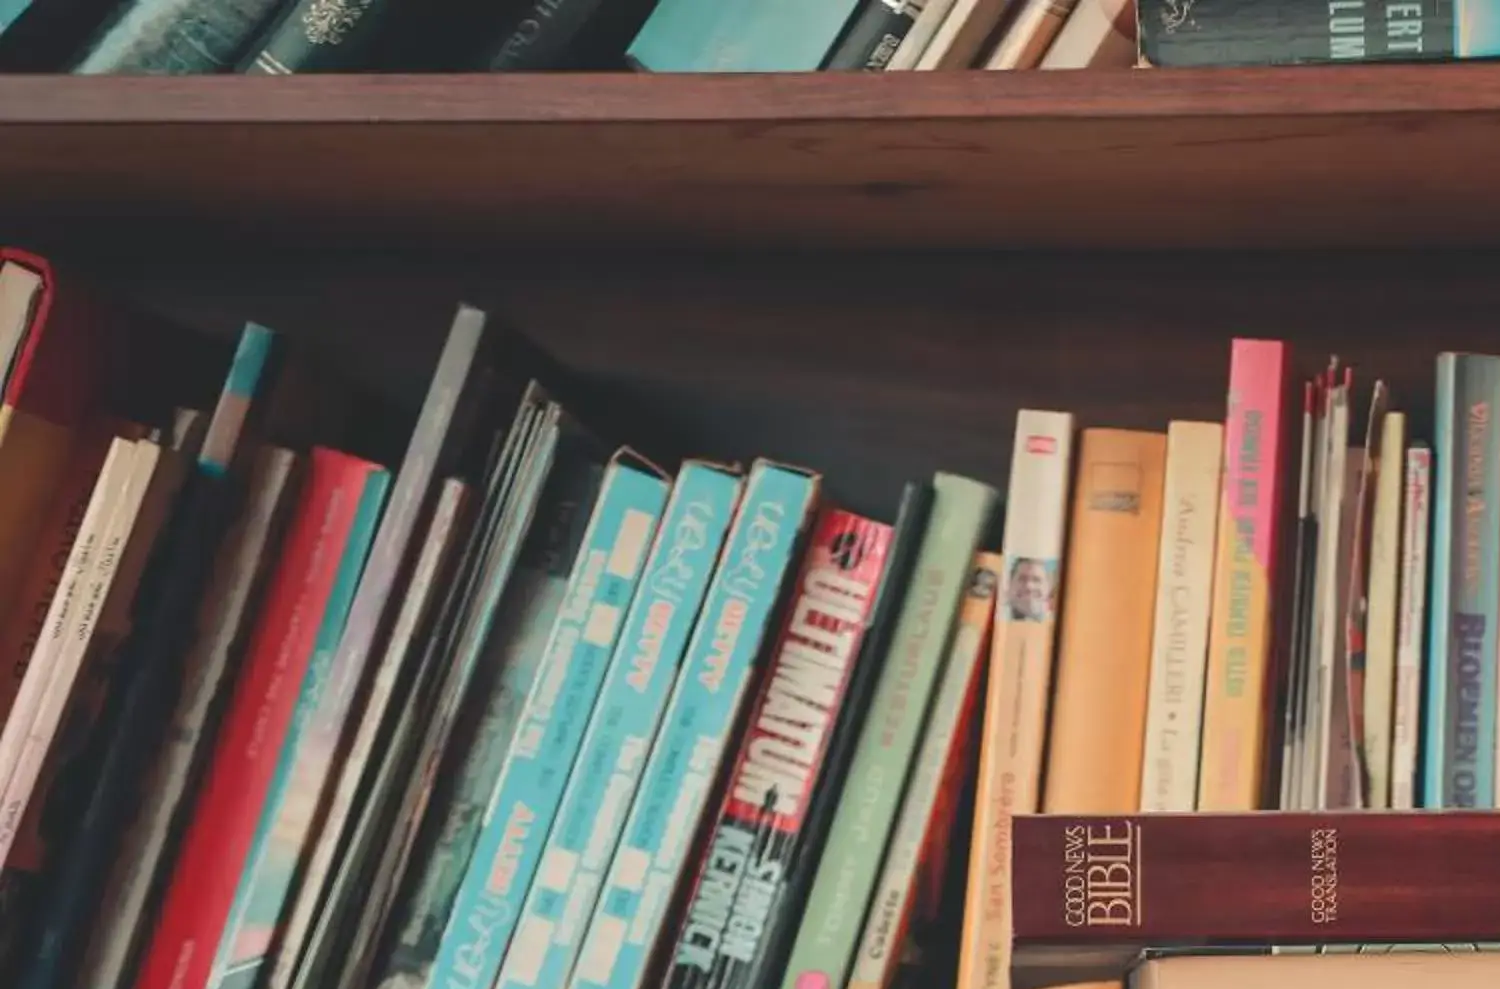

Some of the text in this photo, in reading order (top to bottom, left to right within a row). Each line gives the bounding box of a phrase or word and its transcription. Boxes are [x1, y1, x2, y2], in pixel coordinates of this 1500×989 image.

[730, 566, 872, 818] ULTIMATUM
[849, 762, 887, 846] JAUD
[675, 825, 757, 973] KERNICK
[720, 858, 784, 963] SIMON
[1064, 824, 1086, 928] GOOD NEWS
[1086, 820, 1133, 928] BIBLE
[1311, 828, 1325, 924] GOOD NEWS
[1325, 828, 1338, 924] TRANSLATION
